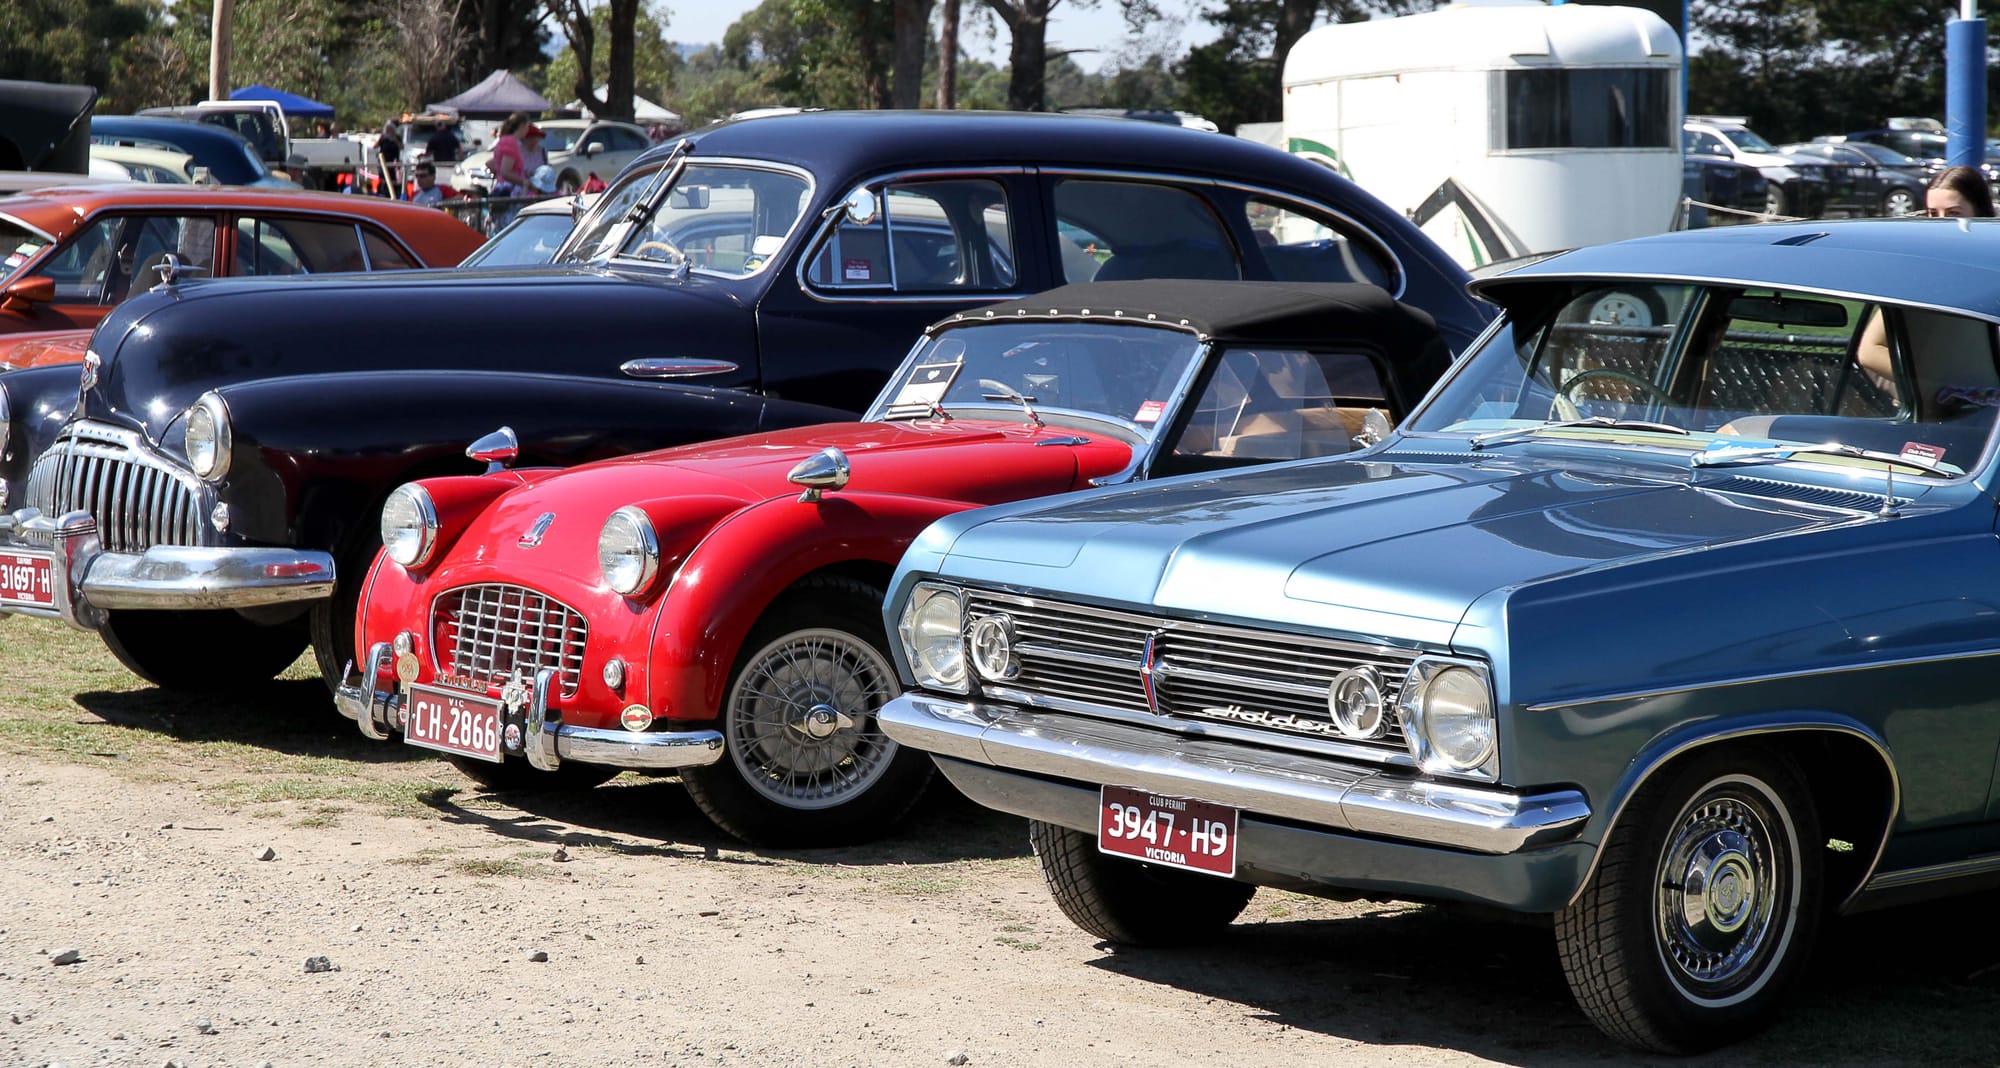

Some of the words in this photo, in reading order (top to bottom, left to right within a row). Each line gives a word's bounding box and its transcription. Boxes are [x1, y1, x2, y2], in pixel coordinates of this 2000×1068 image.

[448, 697, 465, 708] VIC
[1202, 704, 1342, 736] Holden
[1149, 796, 1165, 808] CLUB
[1164, 798, 1187, 812] PERMIT
[1145, 846, 1186, 865] VICTORIA
